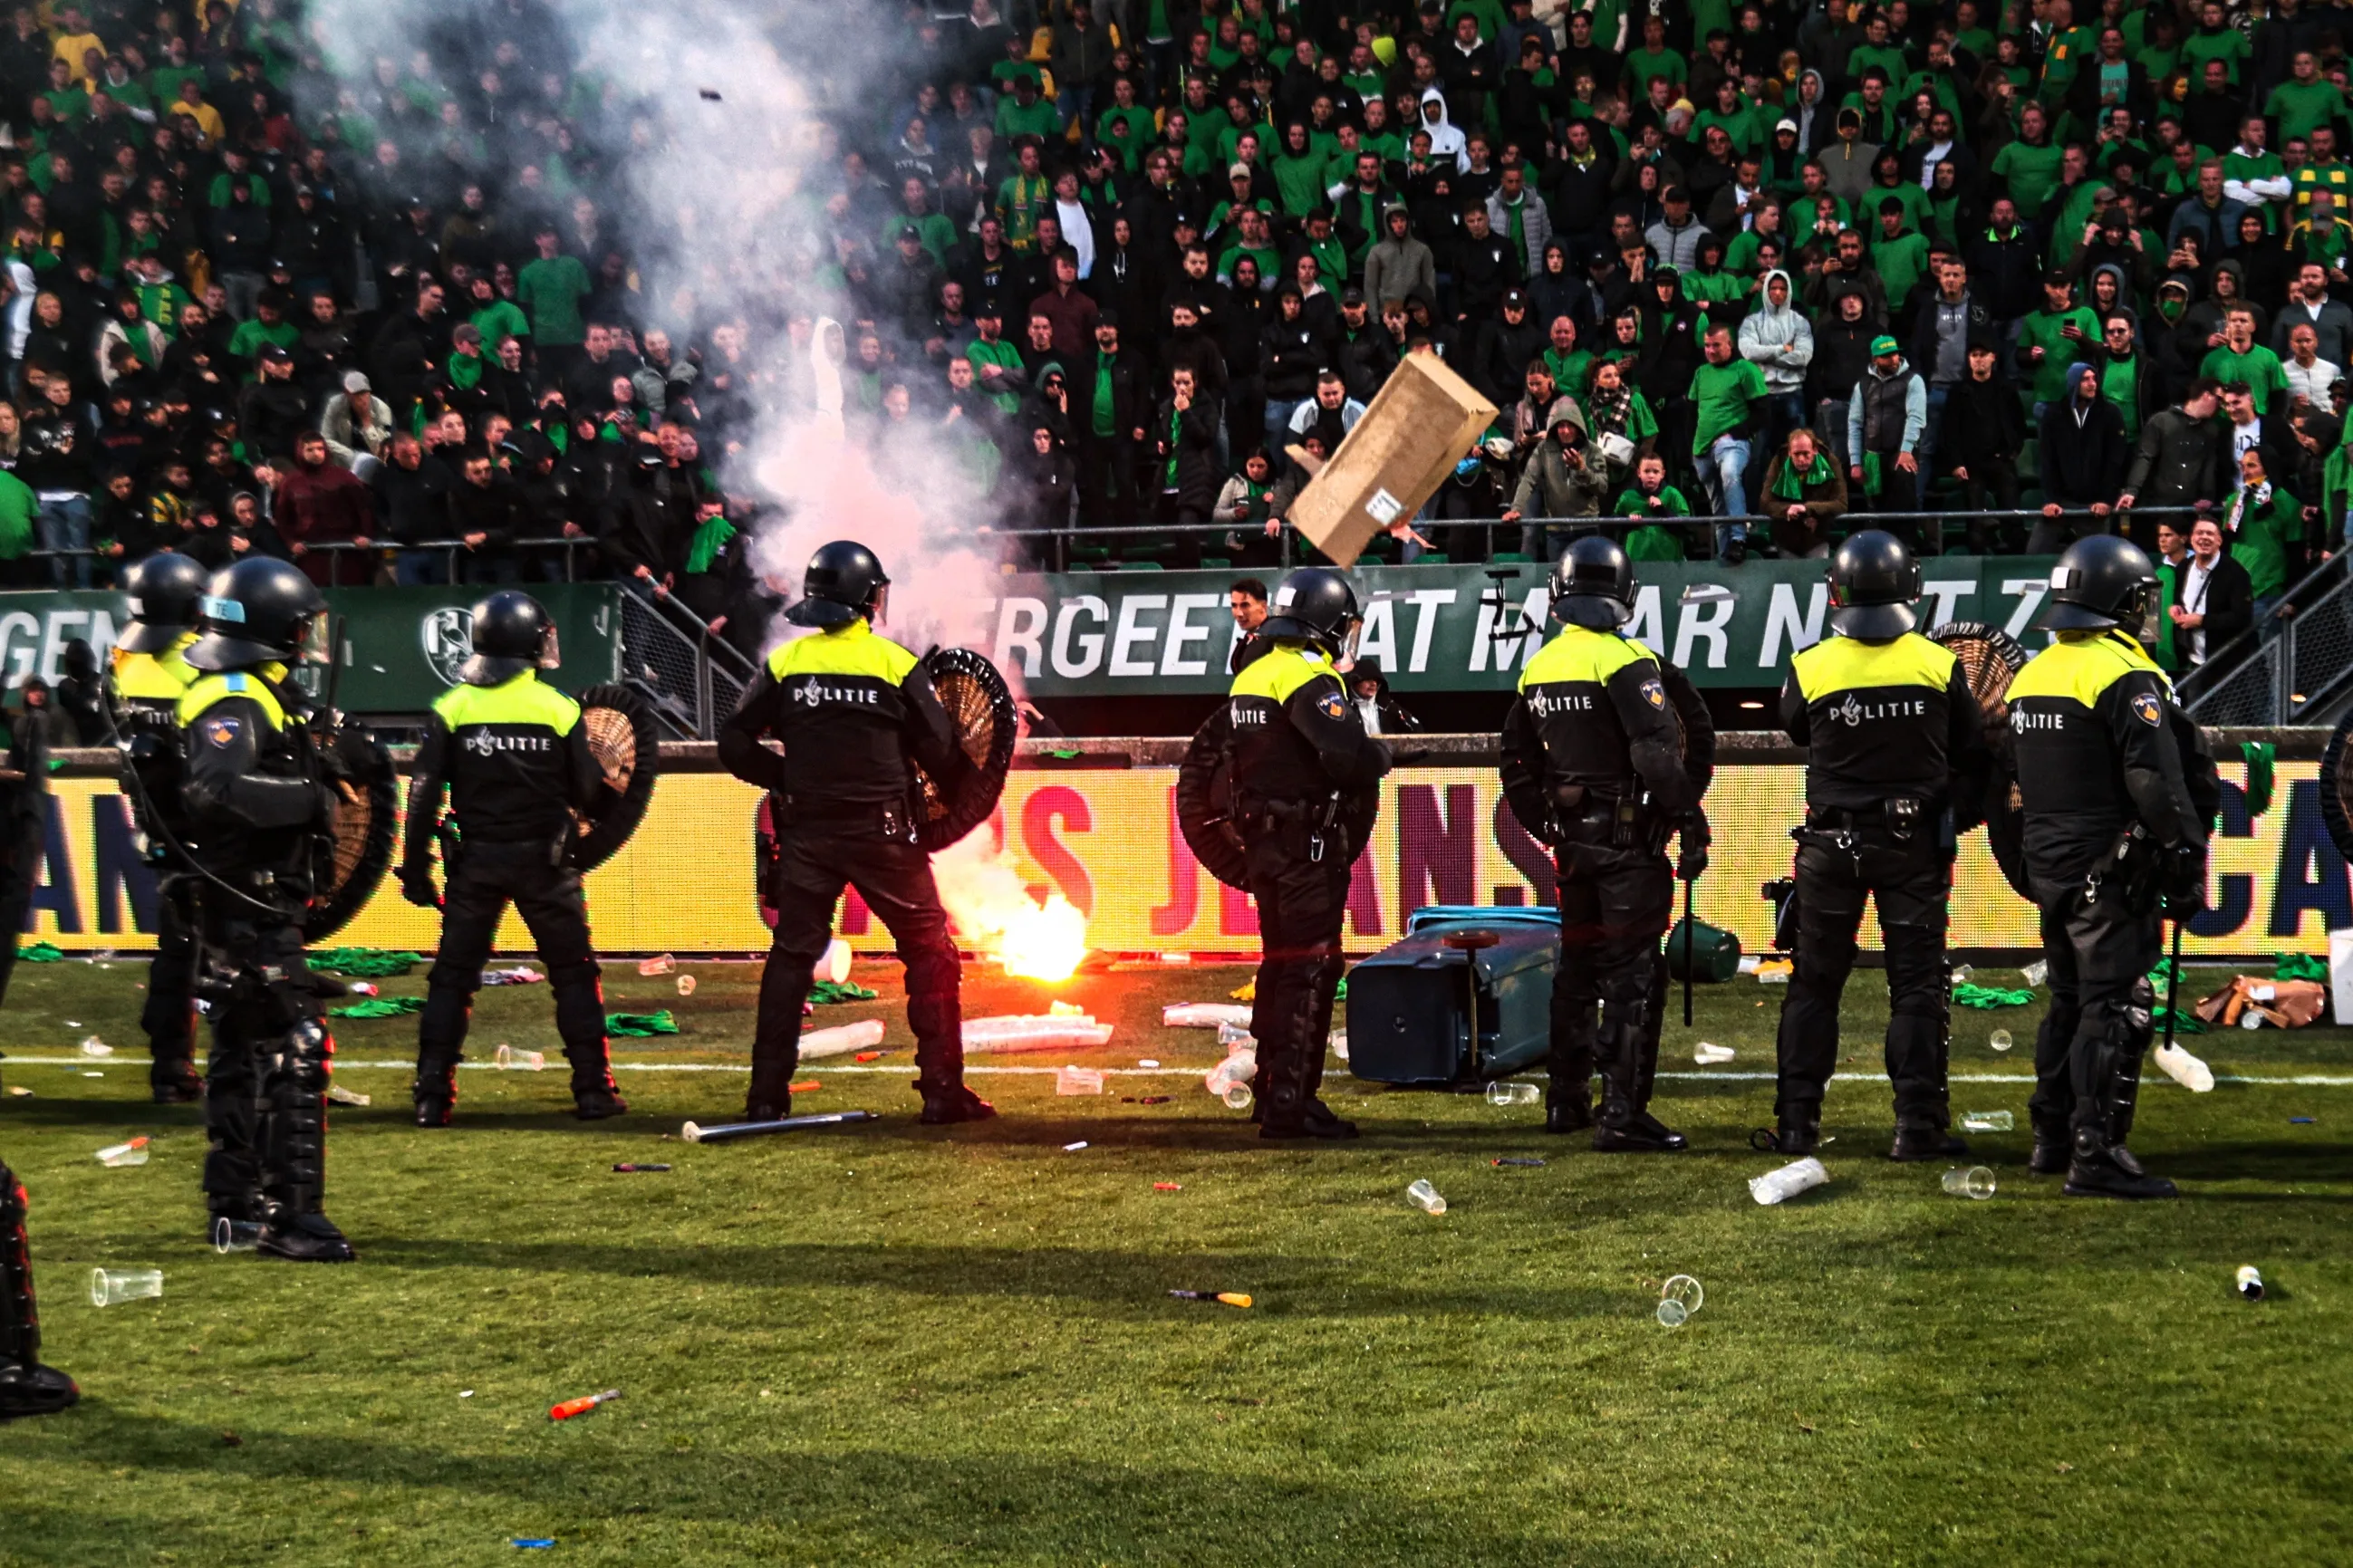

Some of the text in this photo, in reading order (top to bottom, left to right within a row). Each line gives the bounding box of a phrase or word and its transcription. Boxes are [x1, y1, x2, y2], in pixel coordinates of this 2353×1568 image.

[1350, 590, 1455, 672] AT
[1468, 583, 1738, 672] MAR
[1758, 580, 1976, 668] NT
[794, 678, 879, 707] POLITIE
[1528, 688, 1593, 717] POLITIE
[1829, 695, 1925, 726] POLITIE
[2011, 701, 2064, 734] POLITIE
[466, 727, 552, 755] POLITIE
